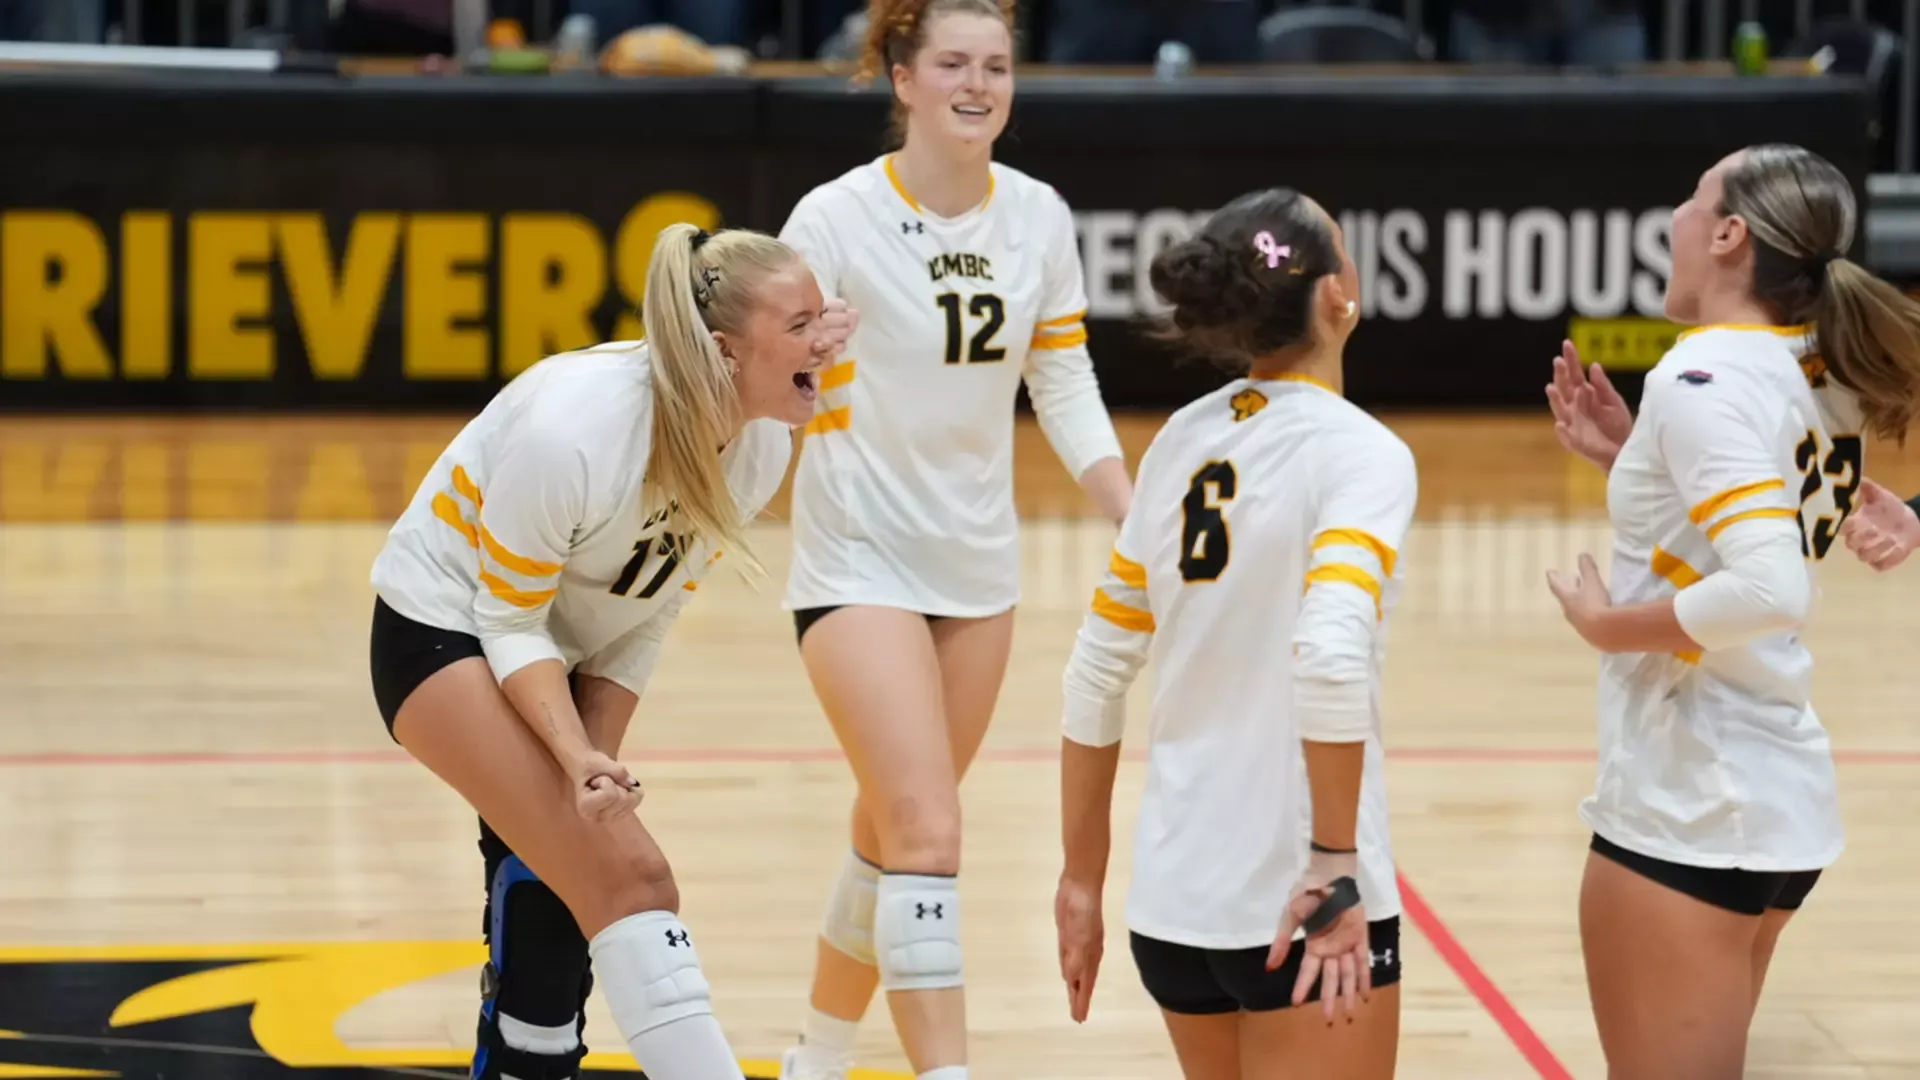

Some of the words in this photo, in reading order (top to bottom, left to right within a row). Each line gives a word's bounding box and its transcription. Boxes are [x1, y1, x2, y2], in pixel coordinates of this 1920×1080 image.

[928, 252, 994, 281] UMBC
[936, 292, 1006, 364] 12
[1180, 459, 1238, 583] 6
[609, 531, 695, 599] 17
